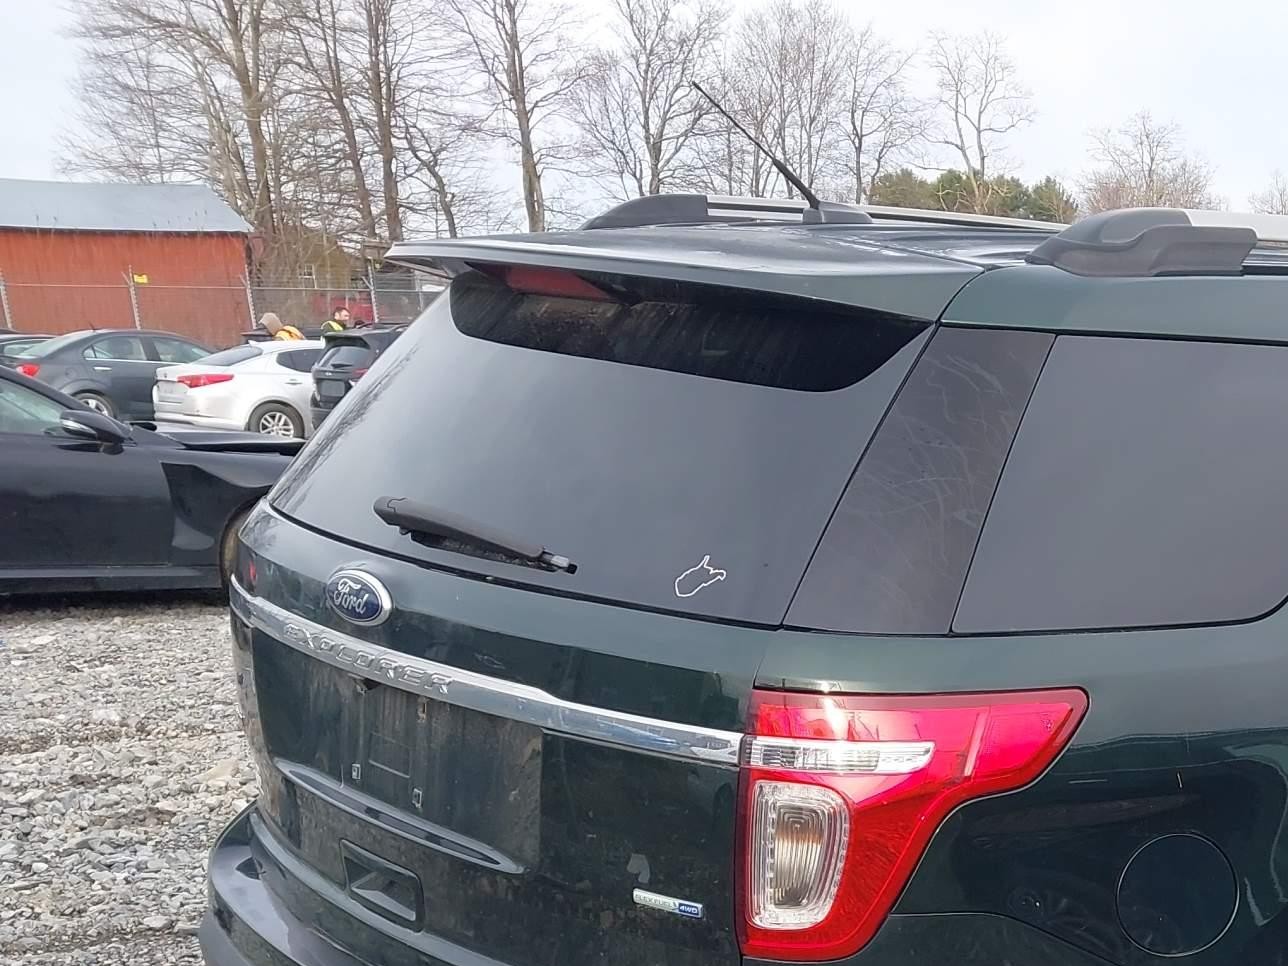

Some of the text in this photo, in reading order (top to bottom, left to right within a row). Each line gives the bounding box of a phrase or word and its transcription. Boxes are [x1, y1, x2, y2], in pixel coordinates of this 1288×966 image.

[333, 578, 369, 615] Ford
[283, 622, 454, 695] EXPLORER
[679, 905, 698, 914] 4WD
